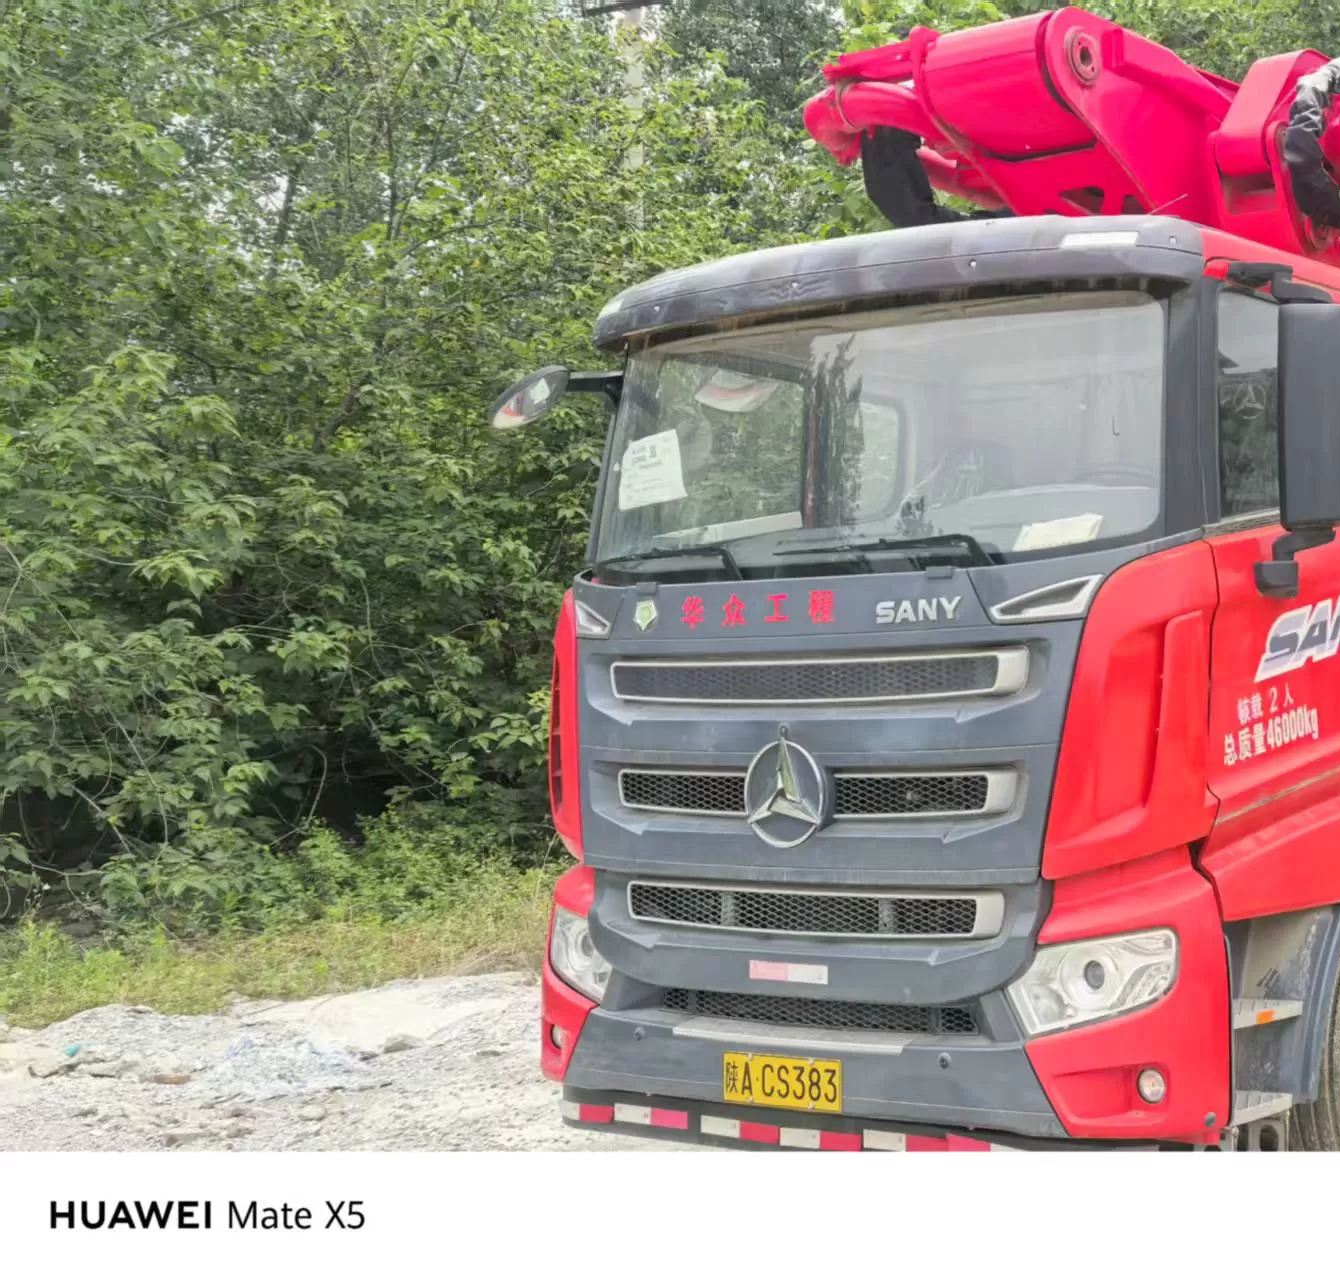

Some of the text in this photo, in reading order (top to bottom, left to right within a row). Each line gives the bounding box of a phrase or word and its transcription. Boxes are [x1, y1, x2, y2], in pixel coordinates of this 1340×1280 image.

[680, 590, 834, 631] 华众工程
[876, 596, 962, 624] SANY
